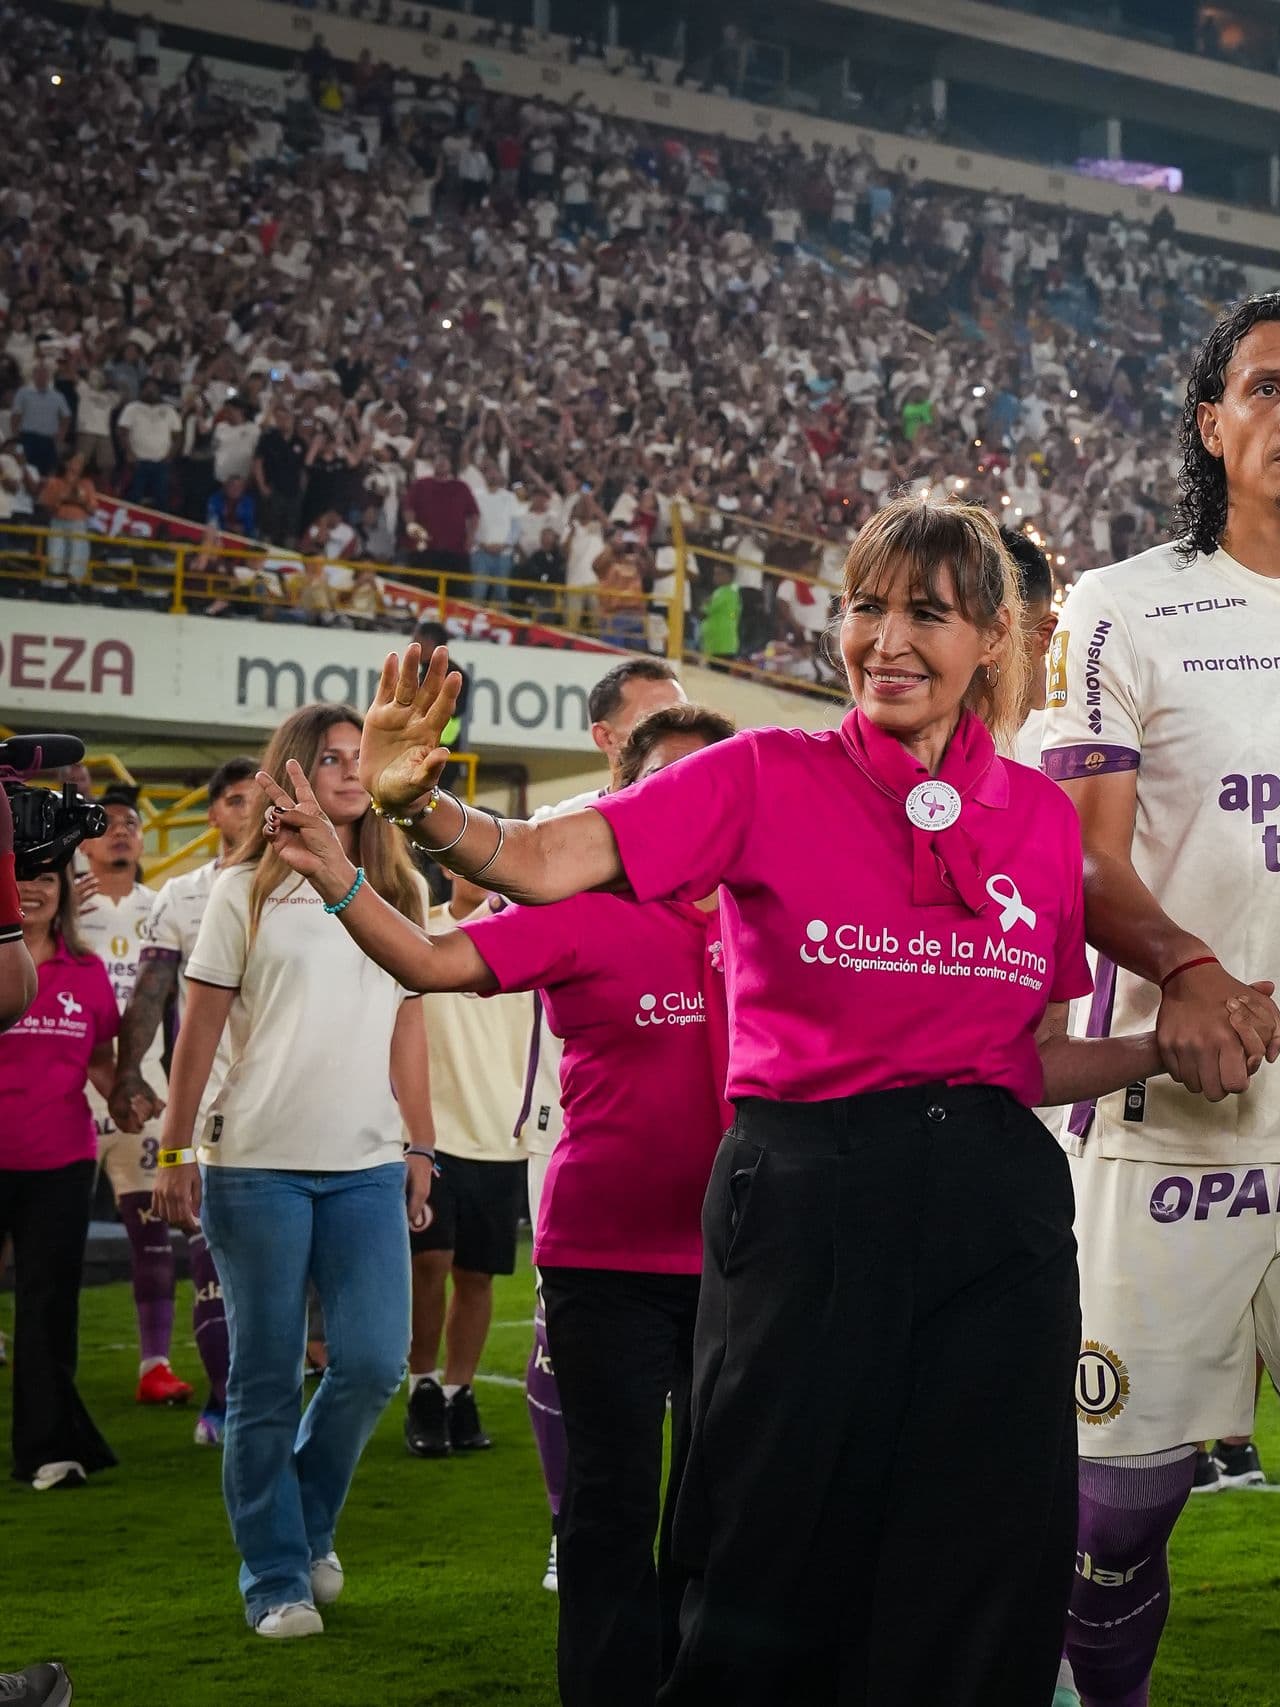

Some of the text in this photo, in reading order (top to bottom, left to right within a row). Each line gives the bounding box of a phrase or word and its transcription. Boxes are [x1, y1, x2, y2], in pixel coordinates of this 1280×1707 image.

[1145, 597, 1248, 618] JETOUR
[0, 633, 135, 696] EZA
[1086, 619, 1113, 706] MOVISUN
[237, 656, 589, 731] marhon
[835, 924, 1047, 975] Club de la Mama
[838, 953, 918, 973] Organización
[921, 959, 936, 975] de
[939, 960, 971, 977] lucha
[974, 966, 1007, 981] contra
[1008, 968, 1019, 983] el
